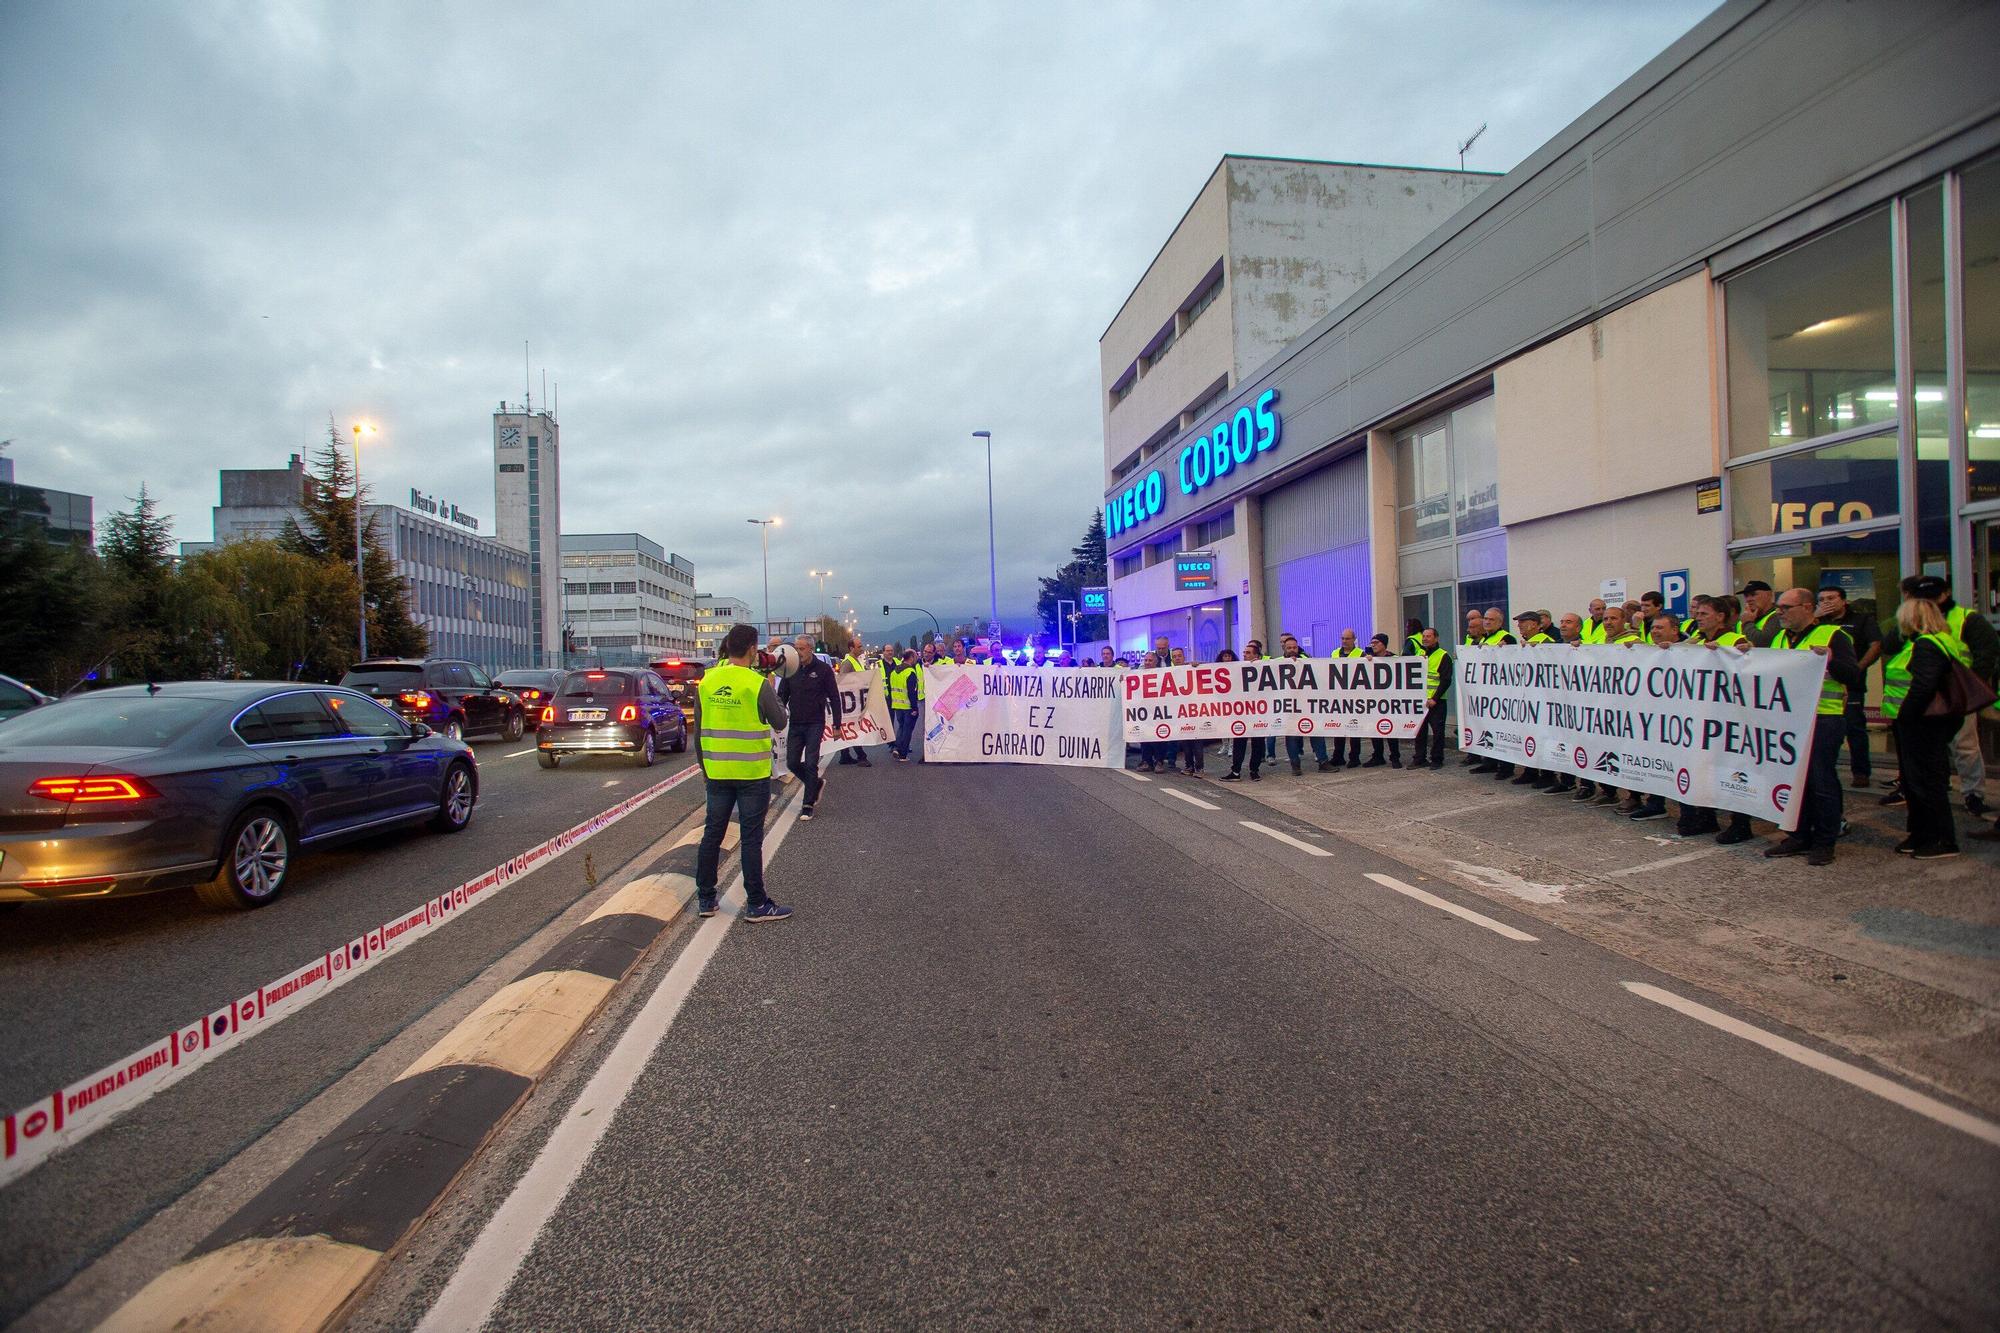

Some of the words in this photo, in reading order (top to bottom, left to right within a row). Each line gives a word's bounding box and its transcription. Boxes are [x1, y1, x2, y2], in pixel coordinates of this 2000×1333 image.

[1105, 470, 1163, 539] IVECO
[1179, 388, 1276, 495] COBOS
[1178, 562, 1211, 571] IVECO
[1084, 593, 1105, 603] OK
[1663, 575, 1685, 610] P
[983, 674, 1043, 698] BALDINTZA
[1052, 676, 1116, 699] KASKARRIK
[1126, 668, 1232, 700] PEAJES
[1241, 663, 1318, 692] PARA
[1328, 662, 1423, 690] NADIE
[1464, 662, 1477, 684] EL
[1561, 664, 1641, 696] NAVARRO
[1647, 666, 1746, 707] CONTRA
[1753, 674, 1791, 712] LA
[1126, 707, 1148, 722] NO
[1153, 705, 1172, 720] AL
[1177, 700, 1268, 718] ABANDONO
[1273, 698, 1302, 713] DEL
[1307, 699, 1424, 715] TRANSPORTE
[982, 733, 1045, 756] GARRAIO
[1058, 735, 1101, 760] DUINA
[1468, 693, 1540, 725] IMPOSICIÓN
[1546, 702, 1634, 739] TRIBUTARIA
[1639, 711, 1653, 741] Y
[1660, 714, 1694, 748] LOS
[1701, 719, 1797, 766] PEAJES
[265, 977, 300, 1007] POLICIA
[300, 964, 325, 988] FORAL
[68, 1071, 126, 1116] POLICIA
[127, 1047, 169, 1082] FORAL
